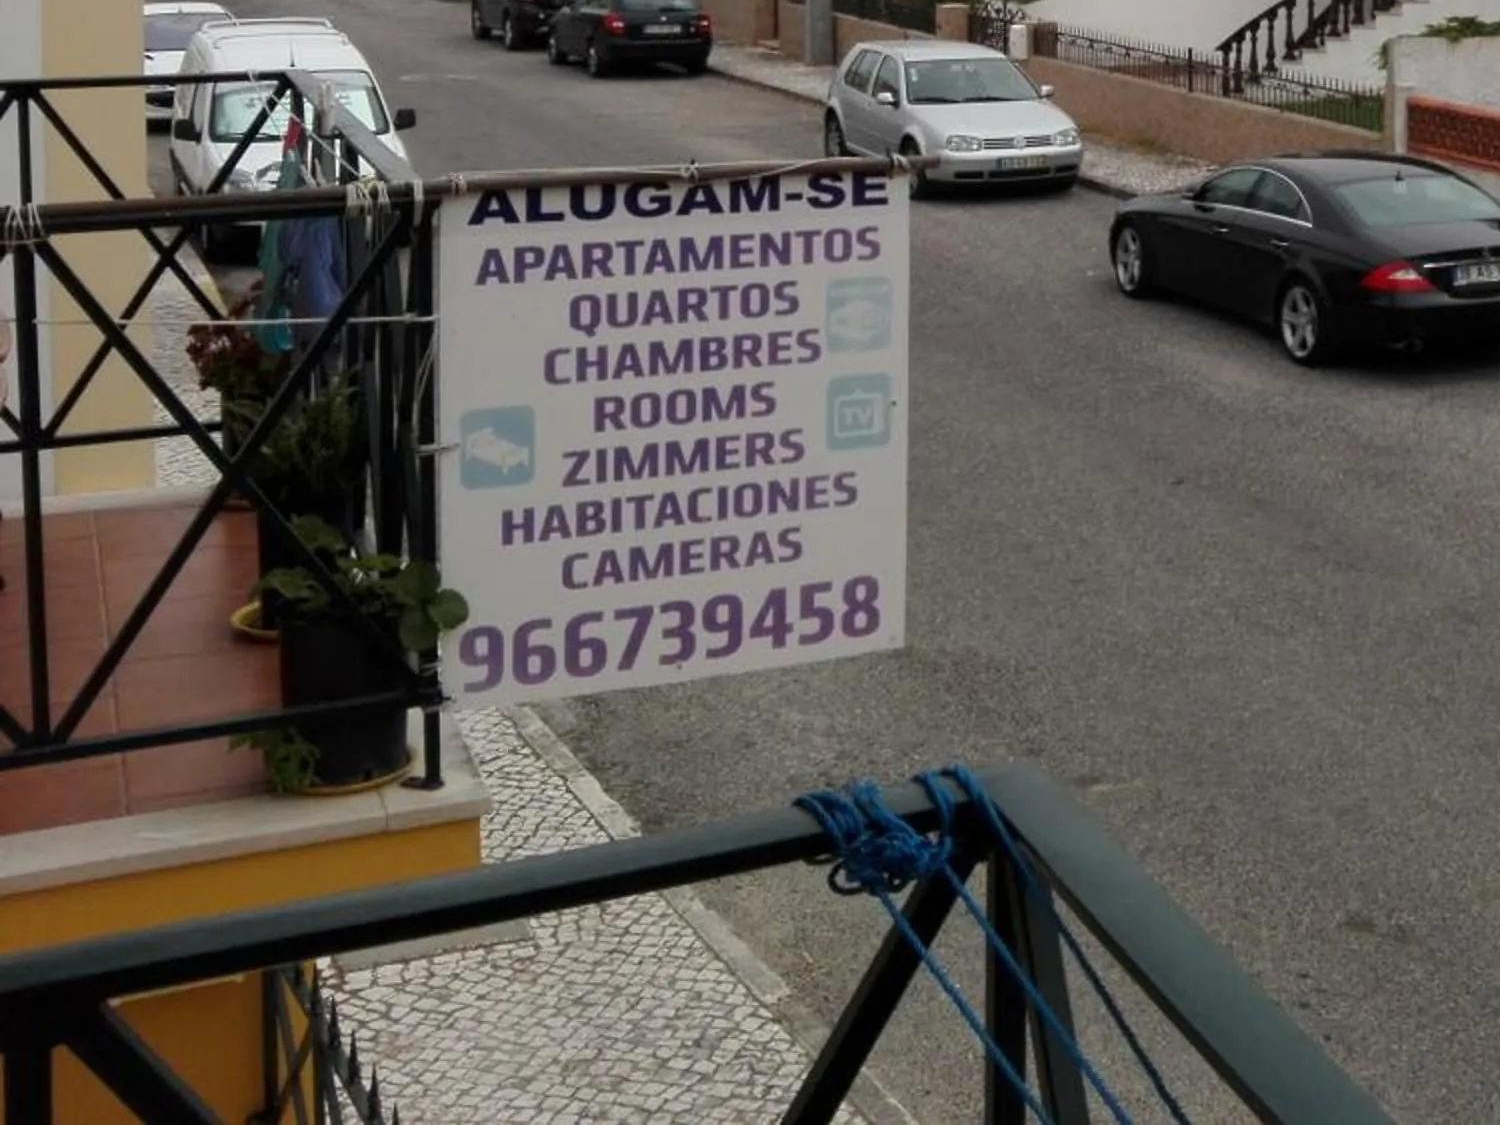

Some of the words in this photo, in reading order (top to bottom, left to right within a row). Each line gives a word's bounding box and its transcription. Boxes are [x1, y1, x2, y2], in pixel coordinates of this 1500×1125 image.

[468, 174, 890, 225] ALUGAM-SE
[475, 226, 881, 286] APARTAMENTOS
[569, 281, 800, 336] QUARTOS
[543, 328, 822, 385] CHAMBRES
[593, 381, 777, 433] ROOMS
[842, 405, 871, 425] TV
[562, 429, 806, 487] ZIMMERS
[501, 472, 859, 546] HABITACIONES
[561, 527, 804, 590] CAMERAS
[458, 576, 881, 693] 966739458
